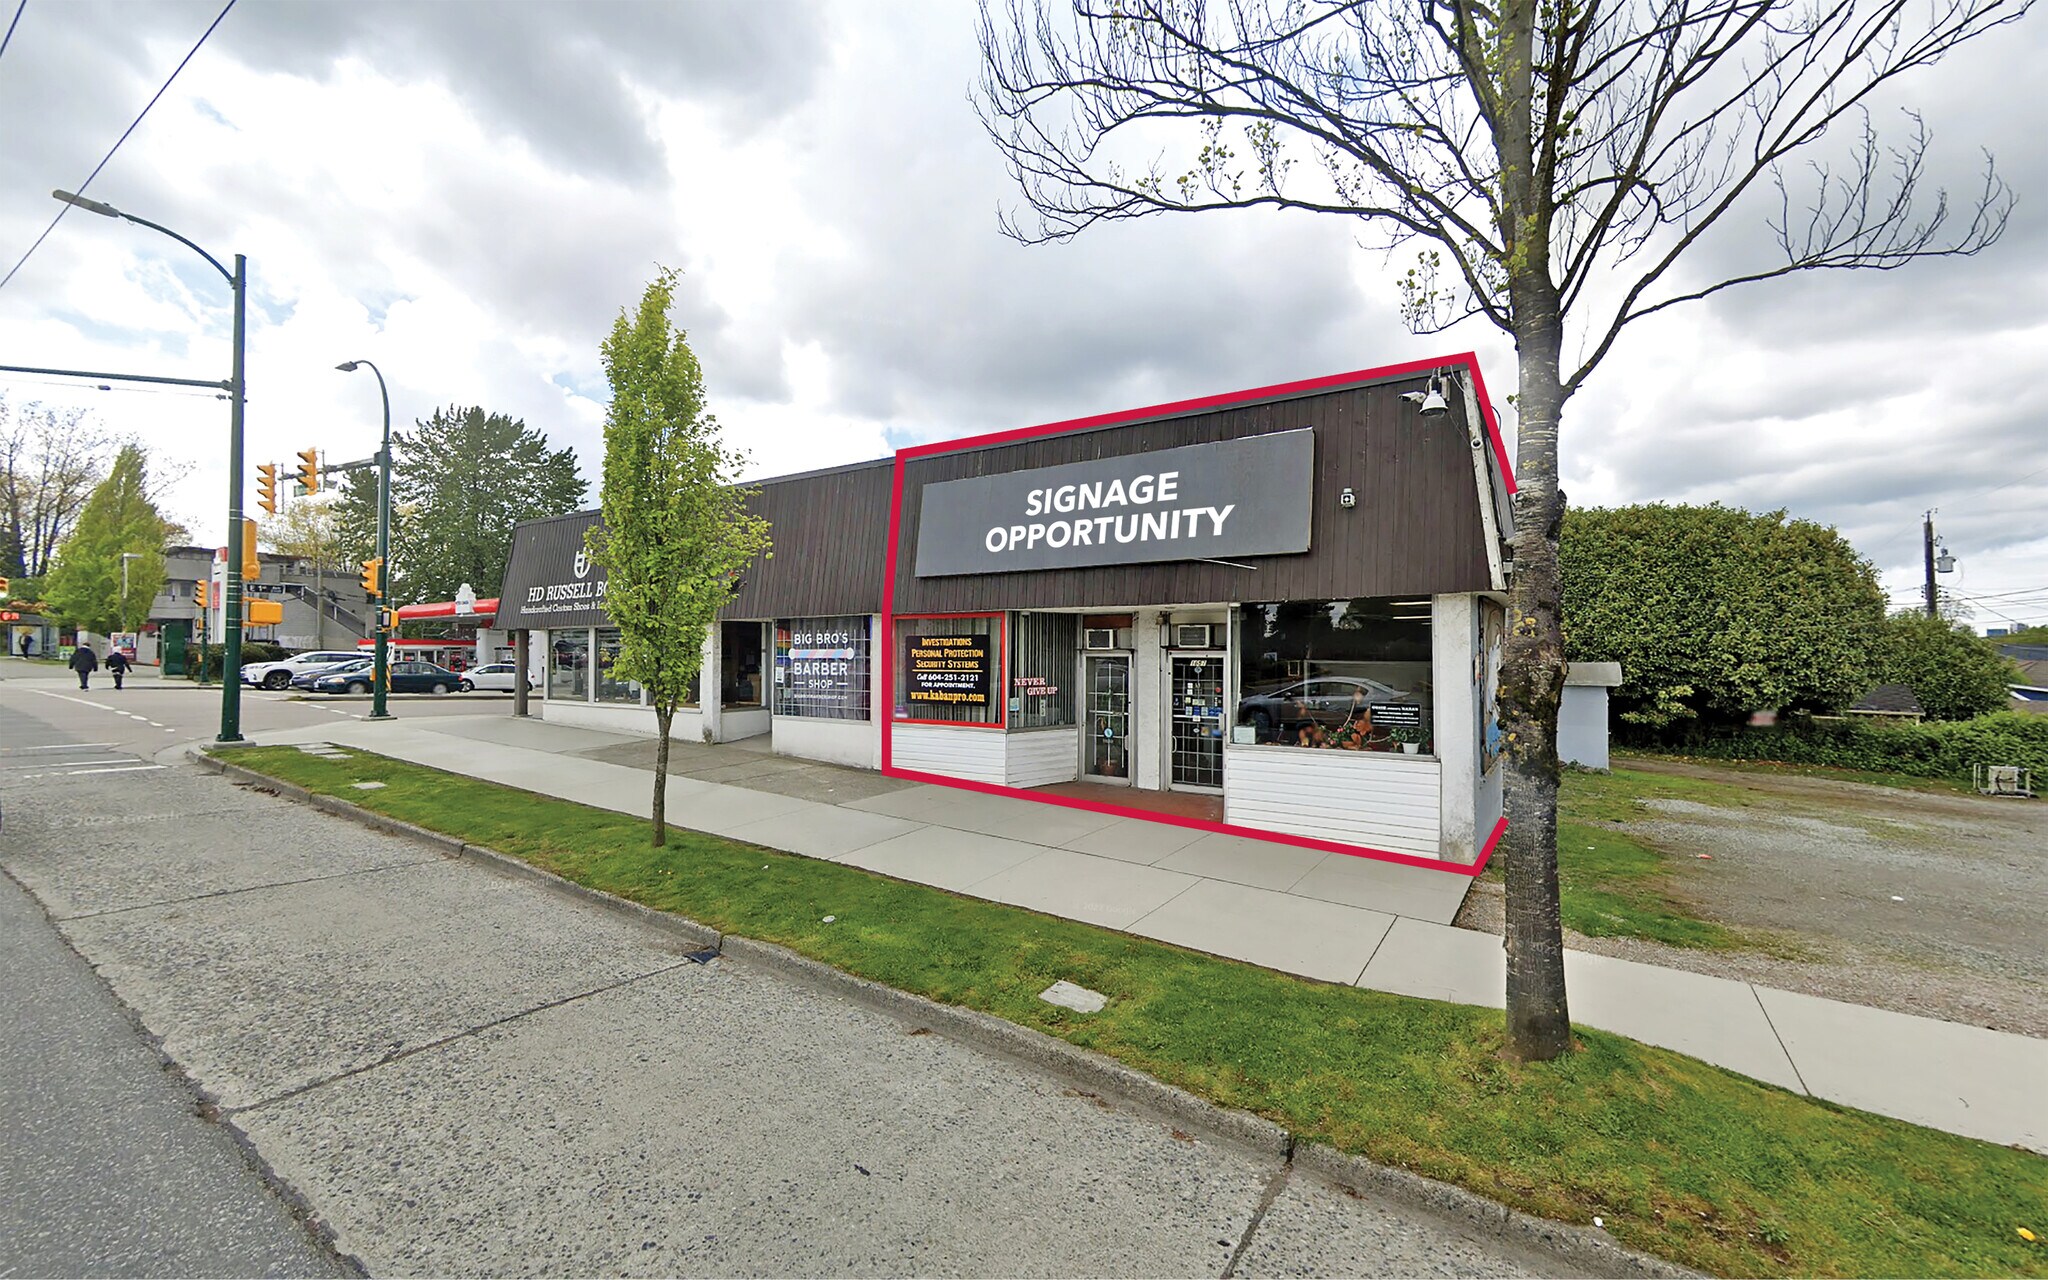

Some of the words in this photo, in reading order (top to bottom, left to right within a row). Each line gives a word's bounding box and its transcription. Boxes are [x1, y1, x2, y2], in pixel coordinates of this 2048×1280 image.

[527, 586, 545, 603] HD
[546, 582, 593, 601] RUSSELL
[552, 603, 573, 612] Custom
[573, 602, 590, 611] Shoes
[794, 633, 812, 644] BIG
[816, 632, 849, 644] BRO'S
[921, 637, 972, 647] INVESTIGATIONS
[911, 648, 943, 658] PERSONAL
[943, 649, 984, 658] PROTECTION
[794, 662, 848, 676] BARBER
[916, 660, 946, 669] SECURITY
[947, 660, 979, 669] SYSTEMS
[928, 673, 979, 682] 604-251-2121
[1014, 677, 1046, 686] NEVER
[808, 679, 833, 689] SHOP
[1027, 687, 1047, 696] GIVE
[1047, 686, 1058, 695] UP
[910, 689, 985, 704] www.kabanpro.com
